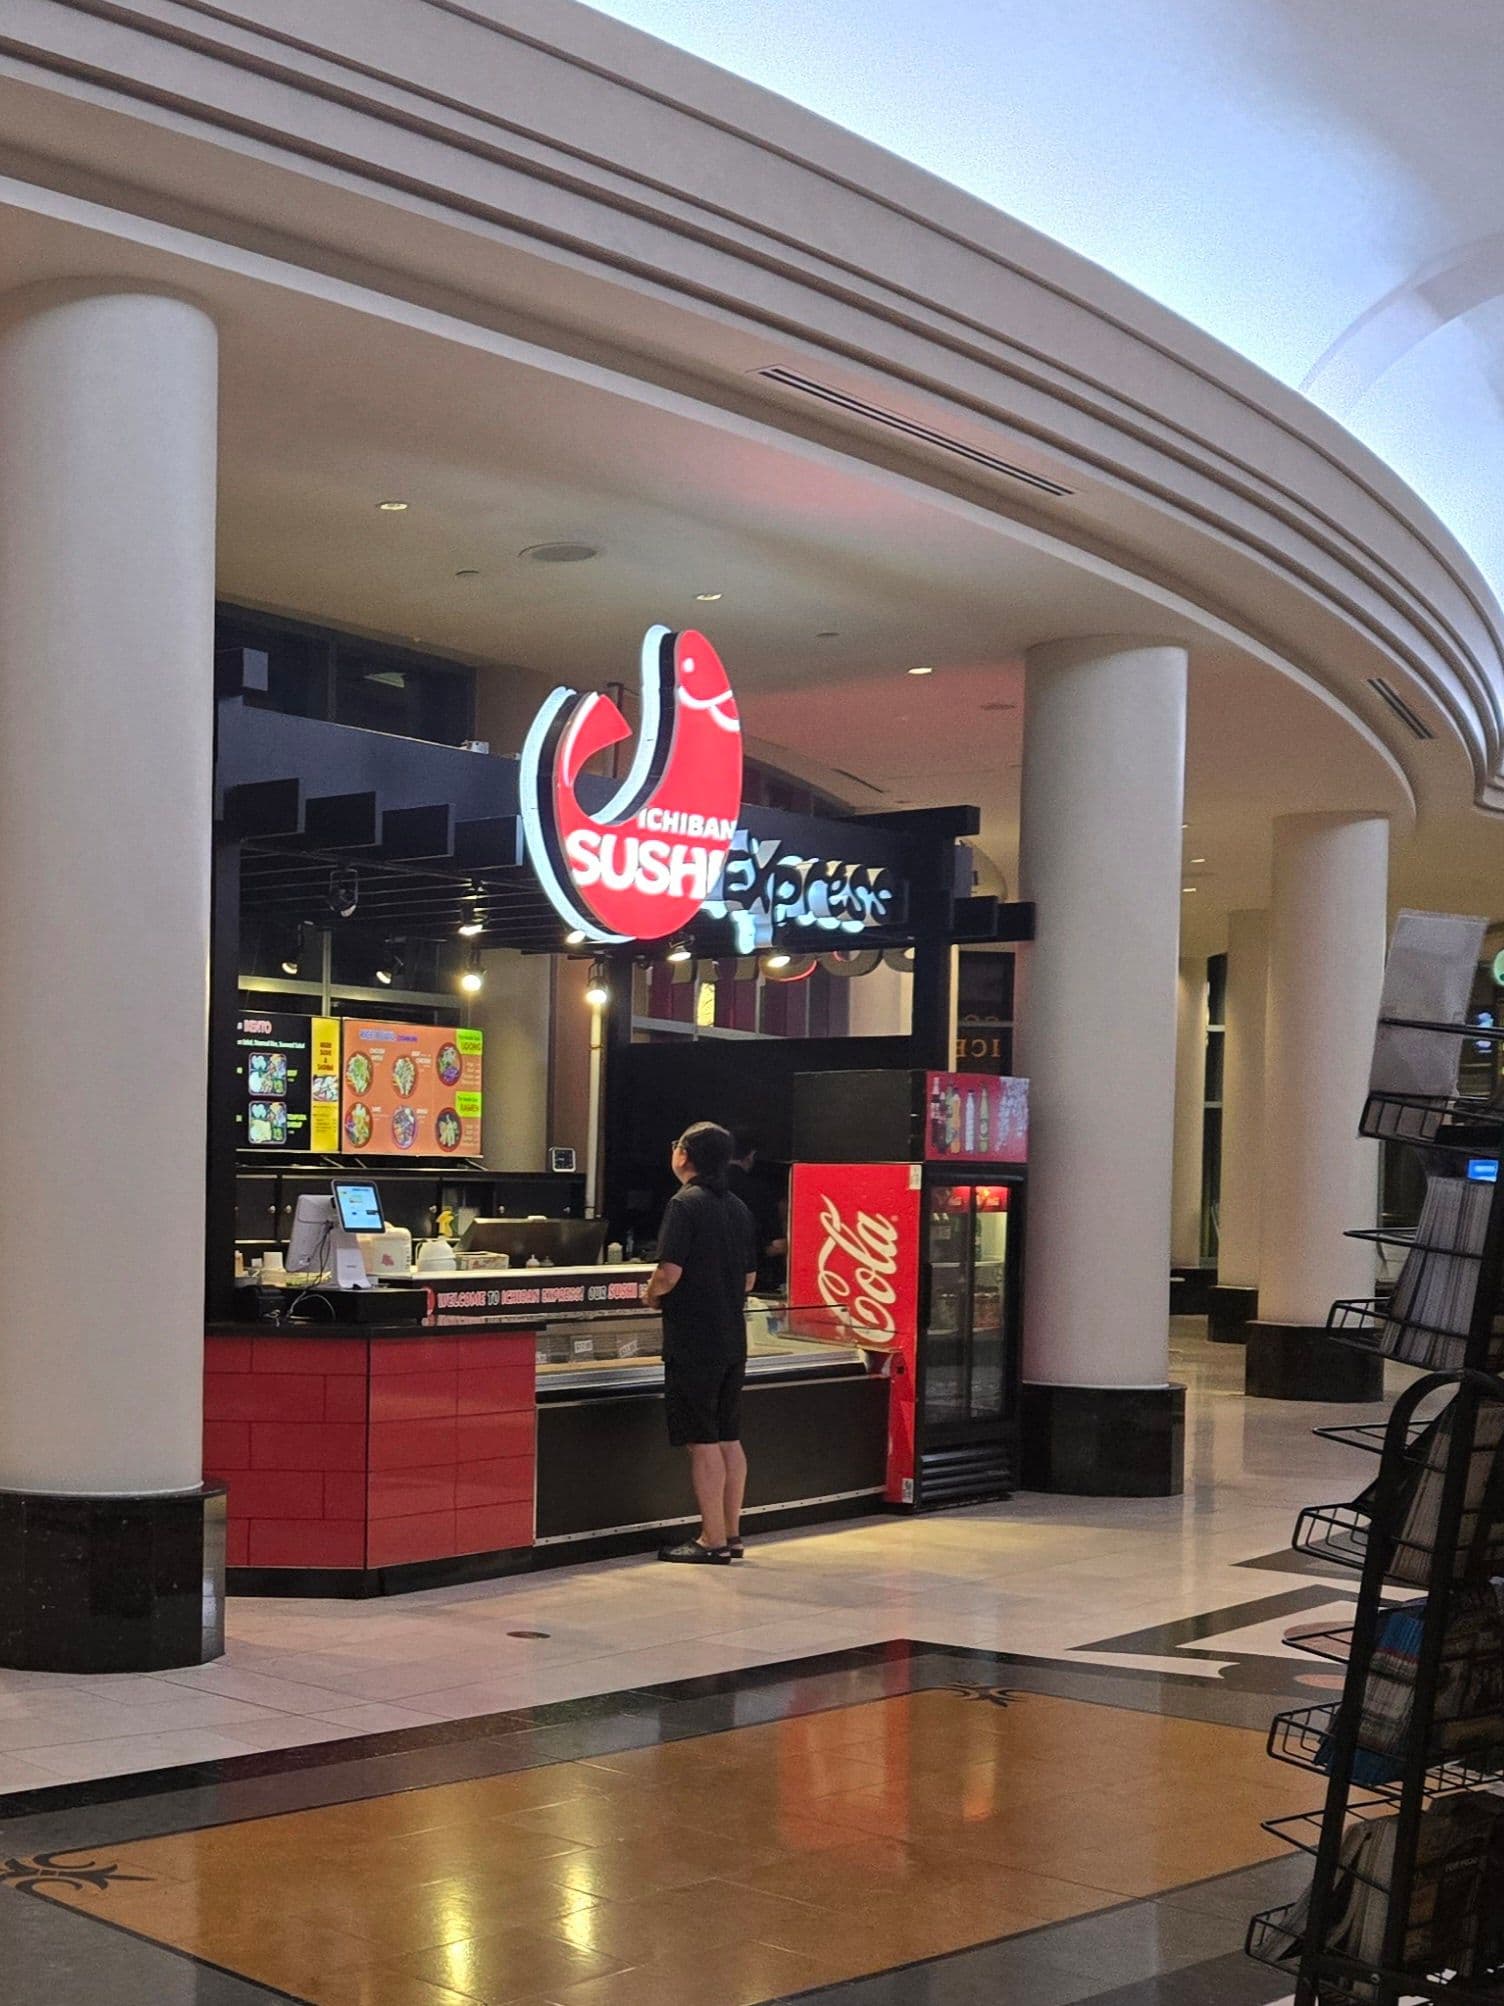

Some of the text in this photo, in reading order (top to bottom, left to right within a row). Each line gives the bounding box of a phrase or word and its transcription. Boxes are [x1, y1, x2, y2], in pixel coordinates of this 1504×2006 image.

[637, 807, 738, 841] ICHIBAN
[566, 829, 726, 899] SUSHI
[437, 1291, 486, 1308] WELCOME
[487, 1290, 500, 1306] TO
